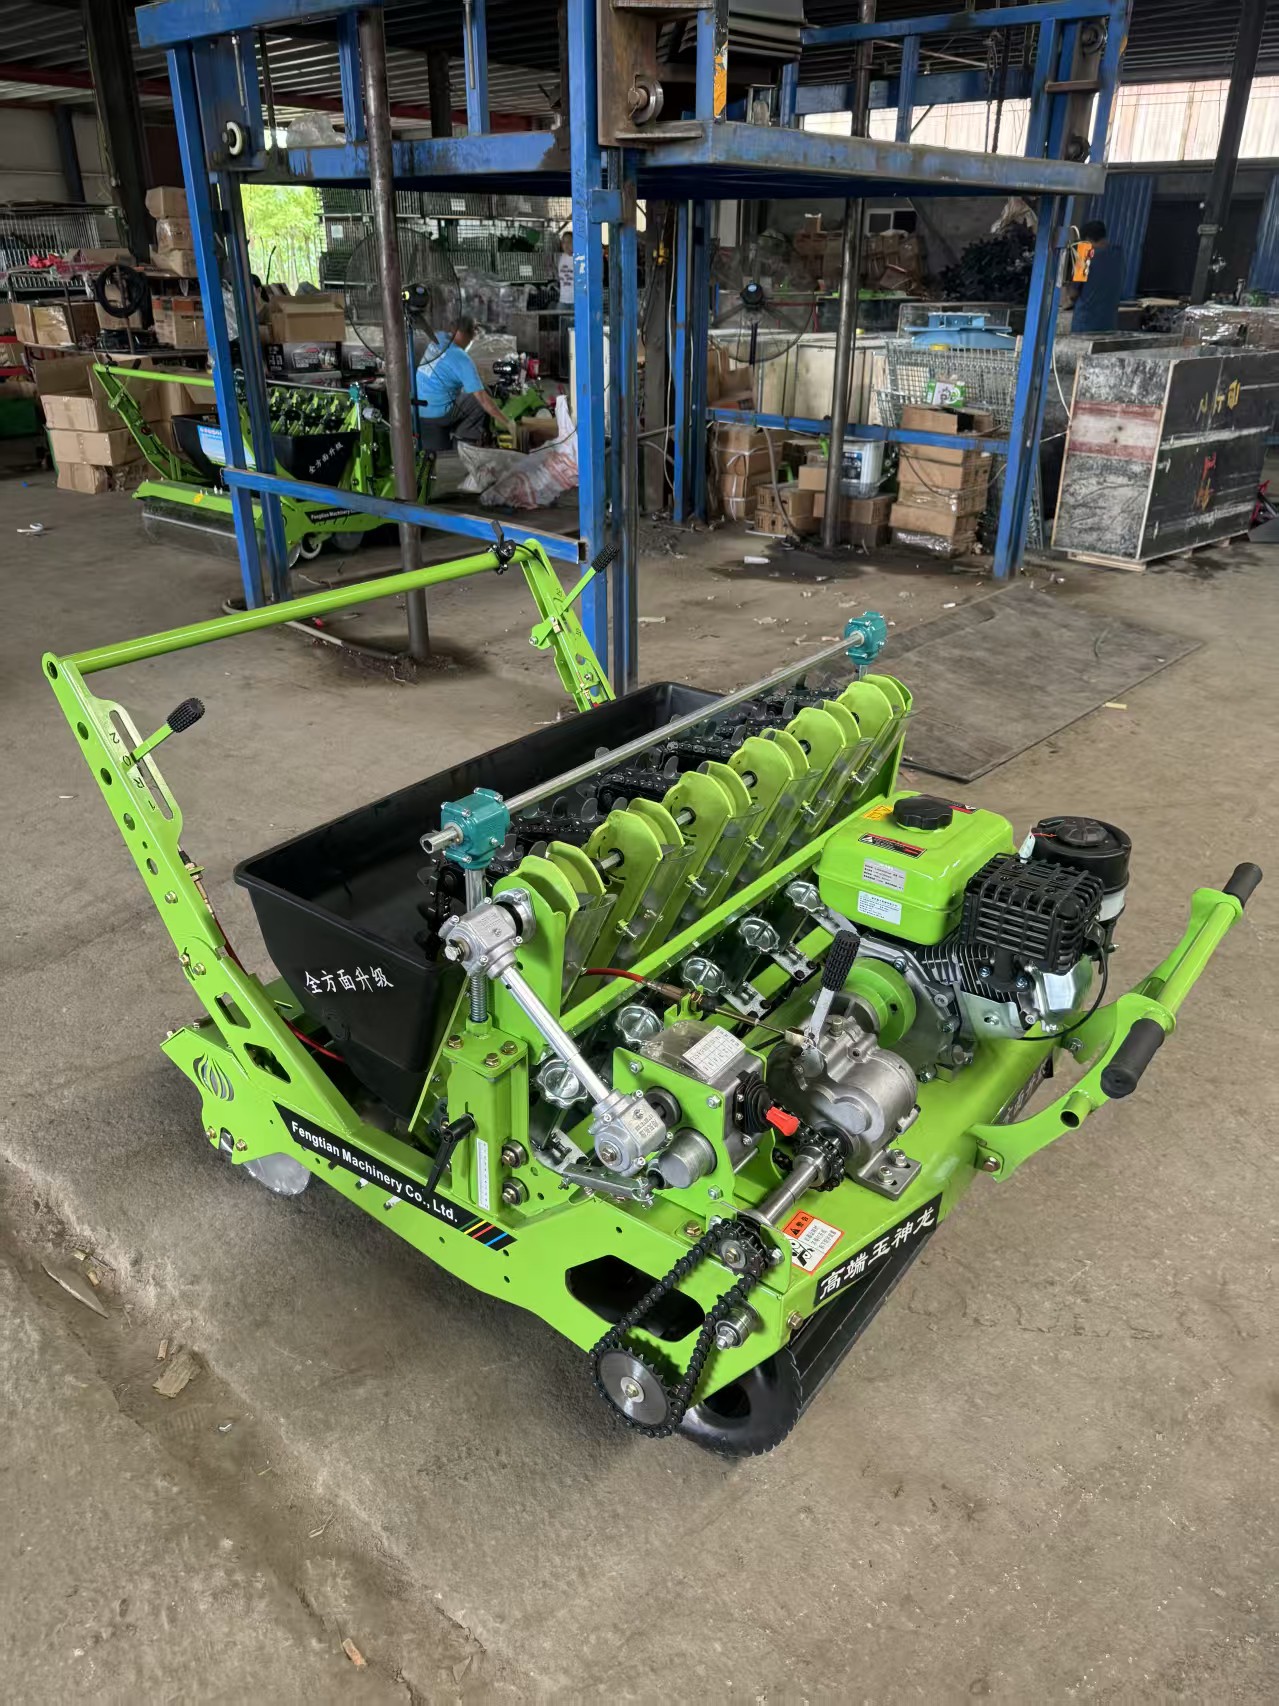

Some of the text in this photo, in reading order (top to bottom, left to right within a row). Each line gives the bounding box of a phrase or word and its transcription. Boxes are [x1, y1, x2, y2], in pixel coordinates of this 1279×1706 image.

[108, 732, 120, 744] 2
[133, 777, 145, 789] R
[305, 966, 394, 994] 全方面升级
[291, 1120, 458, 1223] Fengtian Machinery Co., Ltd.
[819, 1206, 935, 1300] 高端玉神龙
